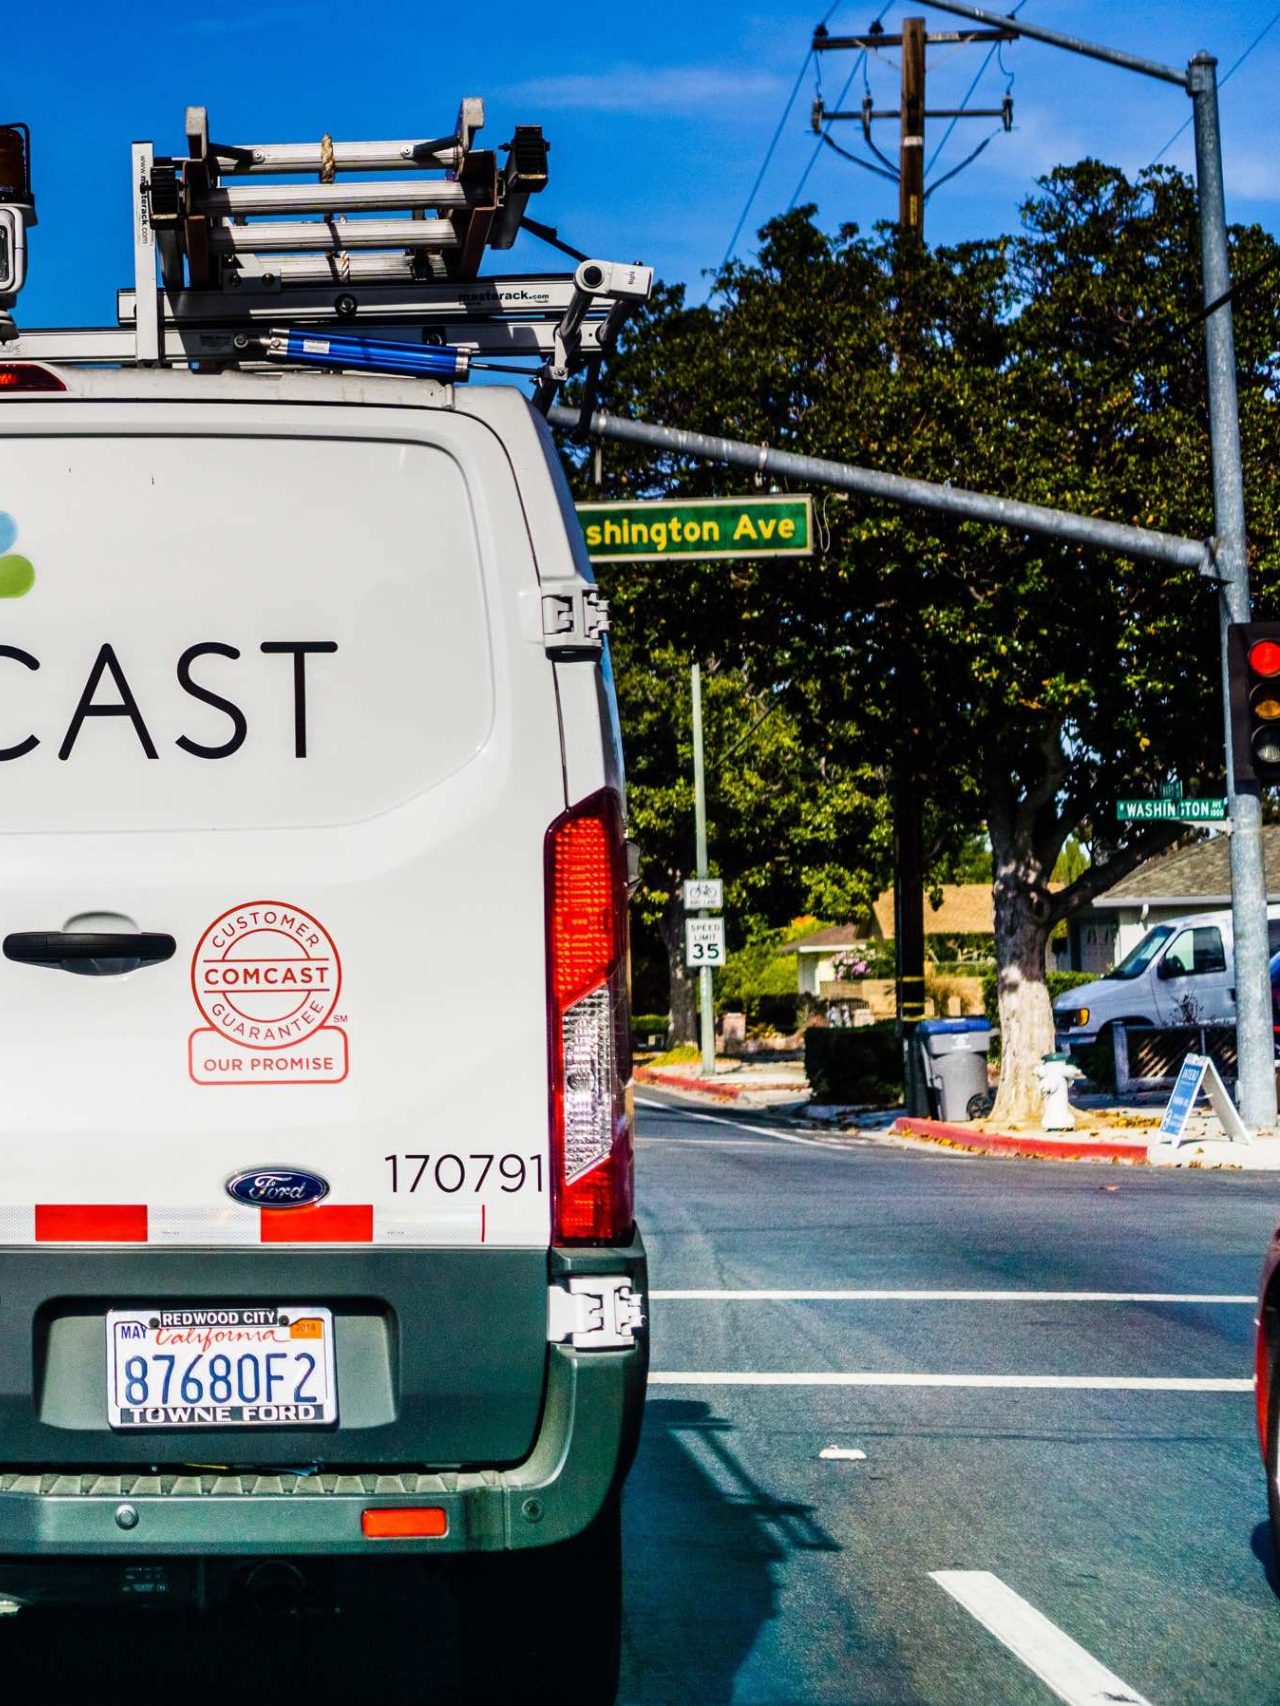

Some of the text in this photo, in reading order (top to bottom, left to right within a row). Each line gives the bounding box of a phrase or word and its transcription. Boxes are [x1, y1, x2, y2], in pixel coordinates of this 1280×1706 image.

[732, 513, 796, 541] Ave
[211, 911, 320, 950] CUSTOMER
[692, 943, 720, 960] 35
[204, 967, 329, 985] COMCAST
[211, 1000, 325, 1041] GUARANTEE
[333, 1014, 348, 1023] SM
[203, 1056, 334, 1072] OUR PROMISE
[384, 1153, 544, 1193] 170791
[248, 1175, 307, 1199] Ford
[162, 1310, 276, 1326] REDWOOD CITY
[121, 1325, 290, 1353] MAY California
[124, 1352, 318, 1406] 87680F2
[129, 1405, 316, 1424] TOWNE FORD
